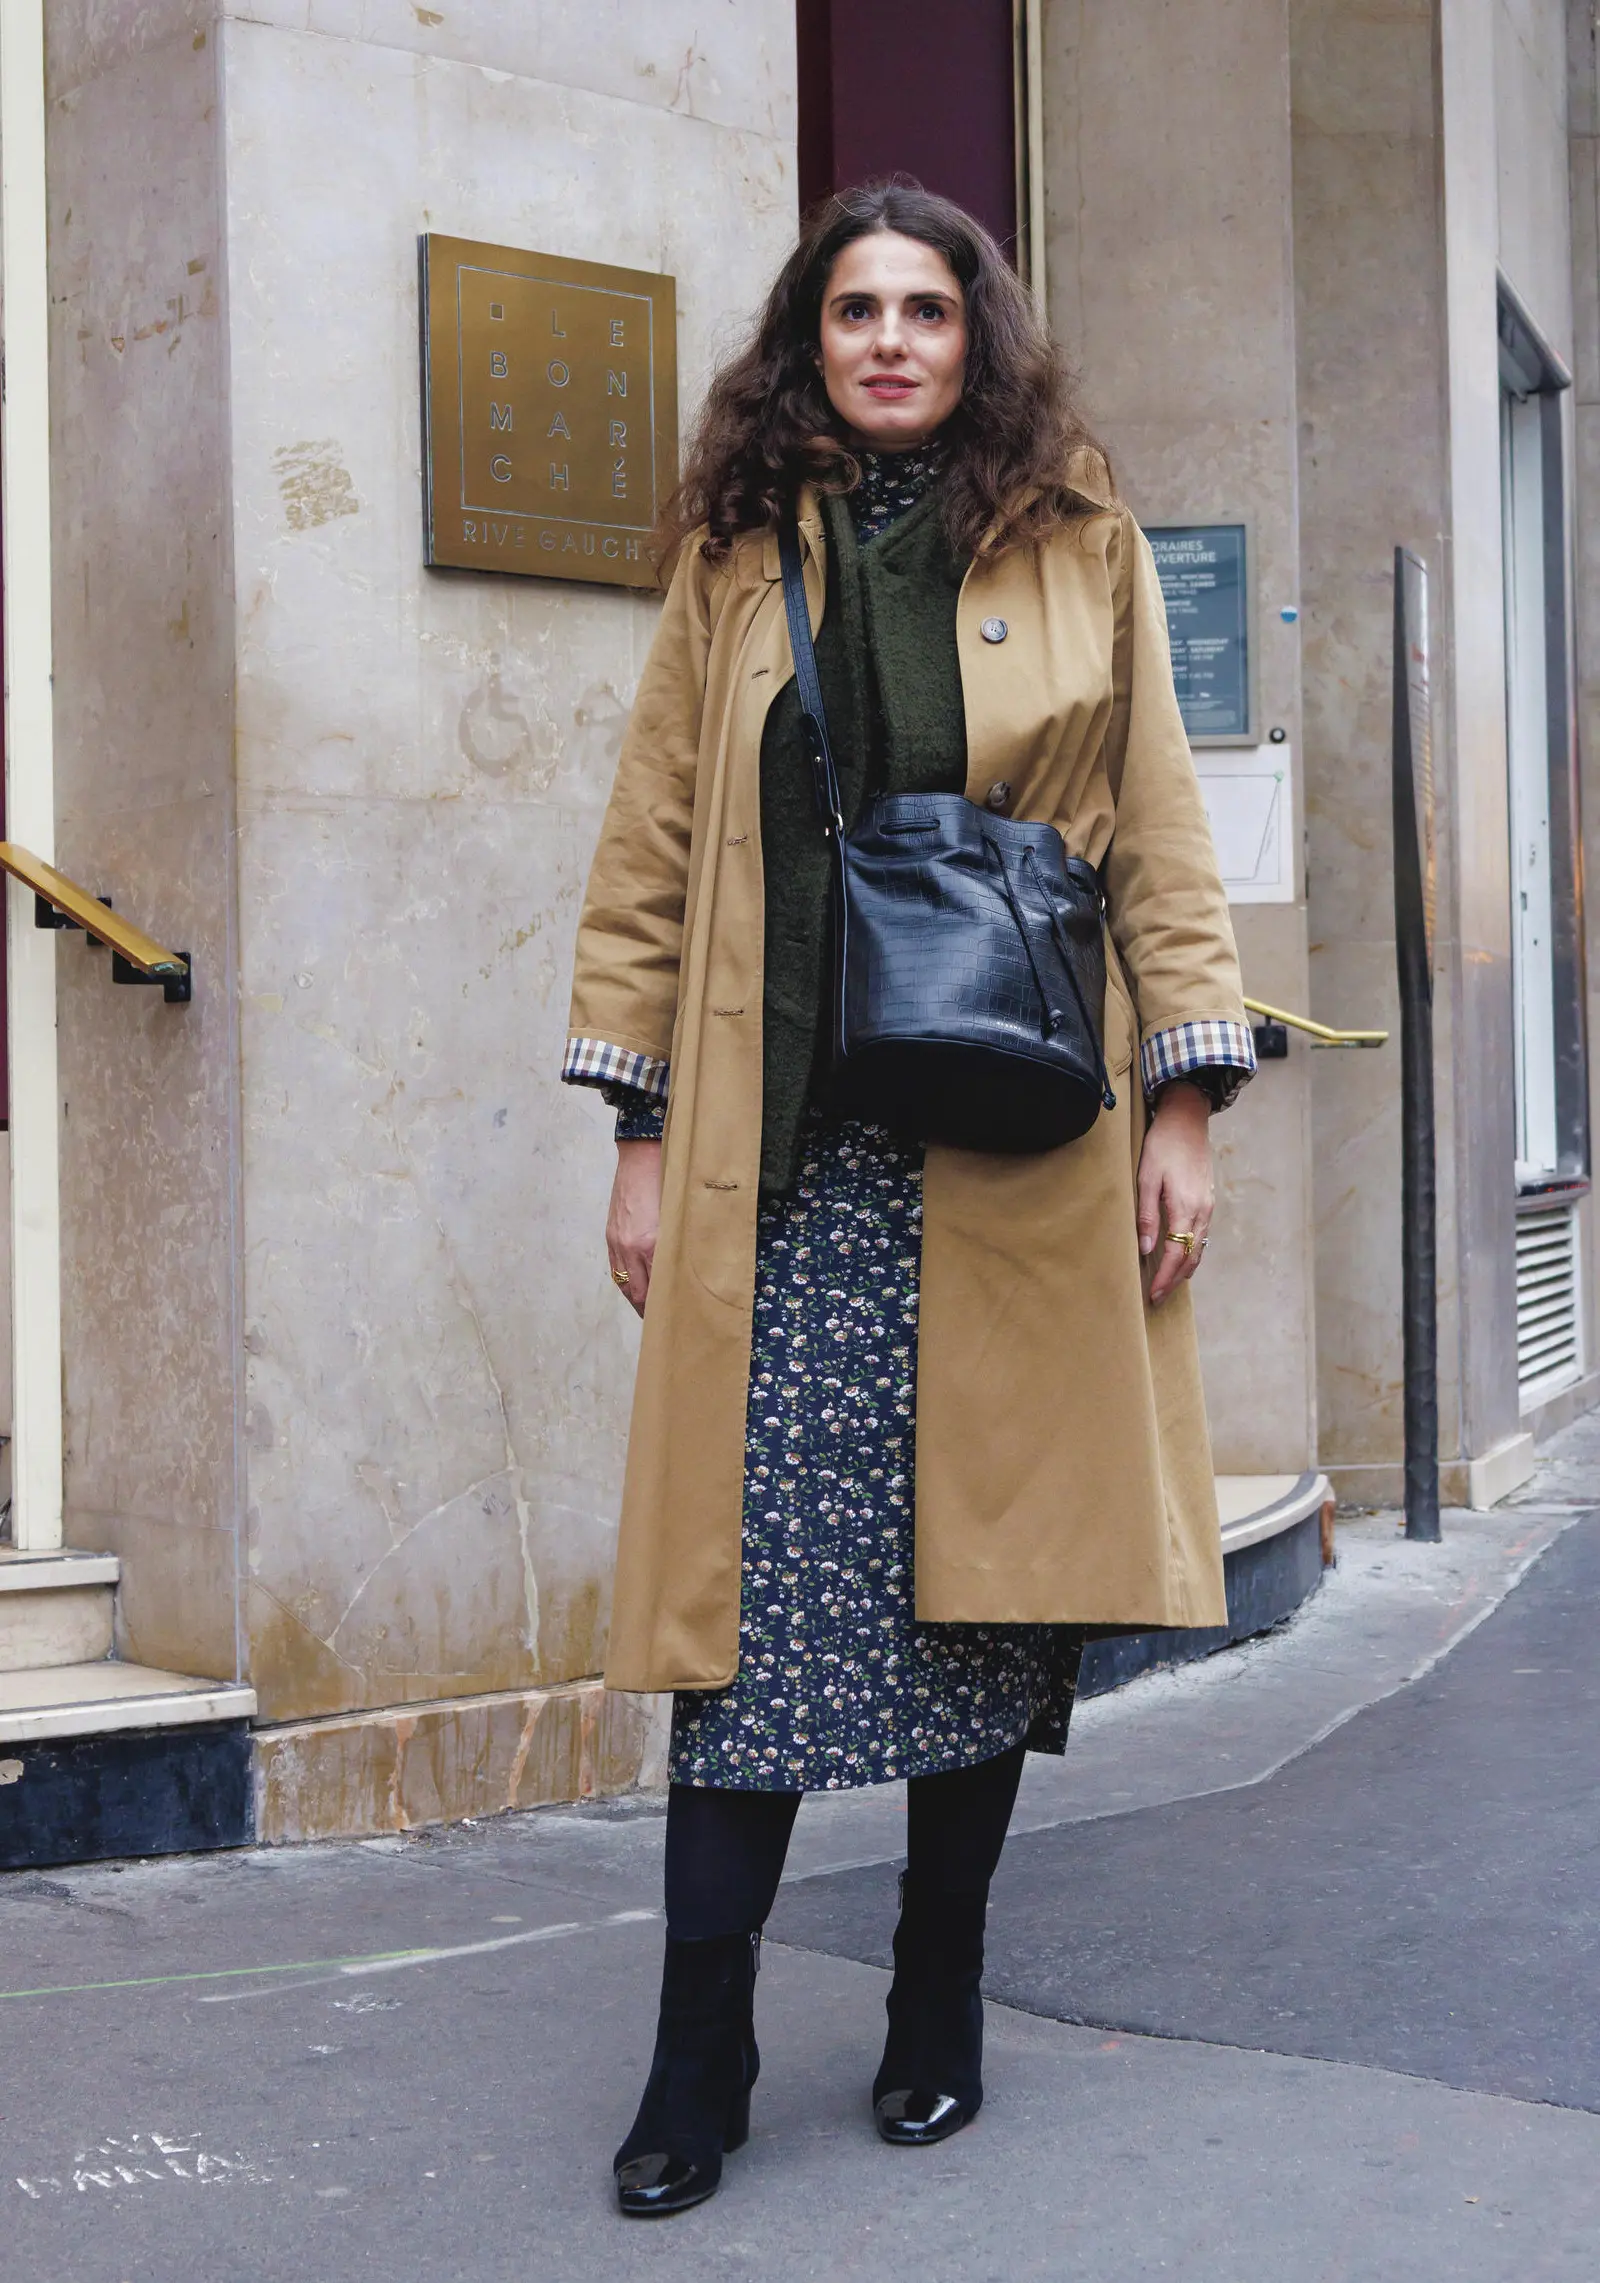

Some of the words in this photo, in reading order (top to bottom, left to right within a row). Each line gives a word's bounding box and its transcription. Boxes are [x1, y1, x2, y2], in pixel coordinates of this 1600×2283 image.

[463, 519, 526, 548] RIVE
[539, 530, 655, 562] GAUCH
[1150, 540, 1204, 553] ORAIRES
[1154, 551, 1217, 564] UVERTURE
